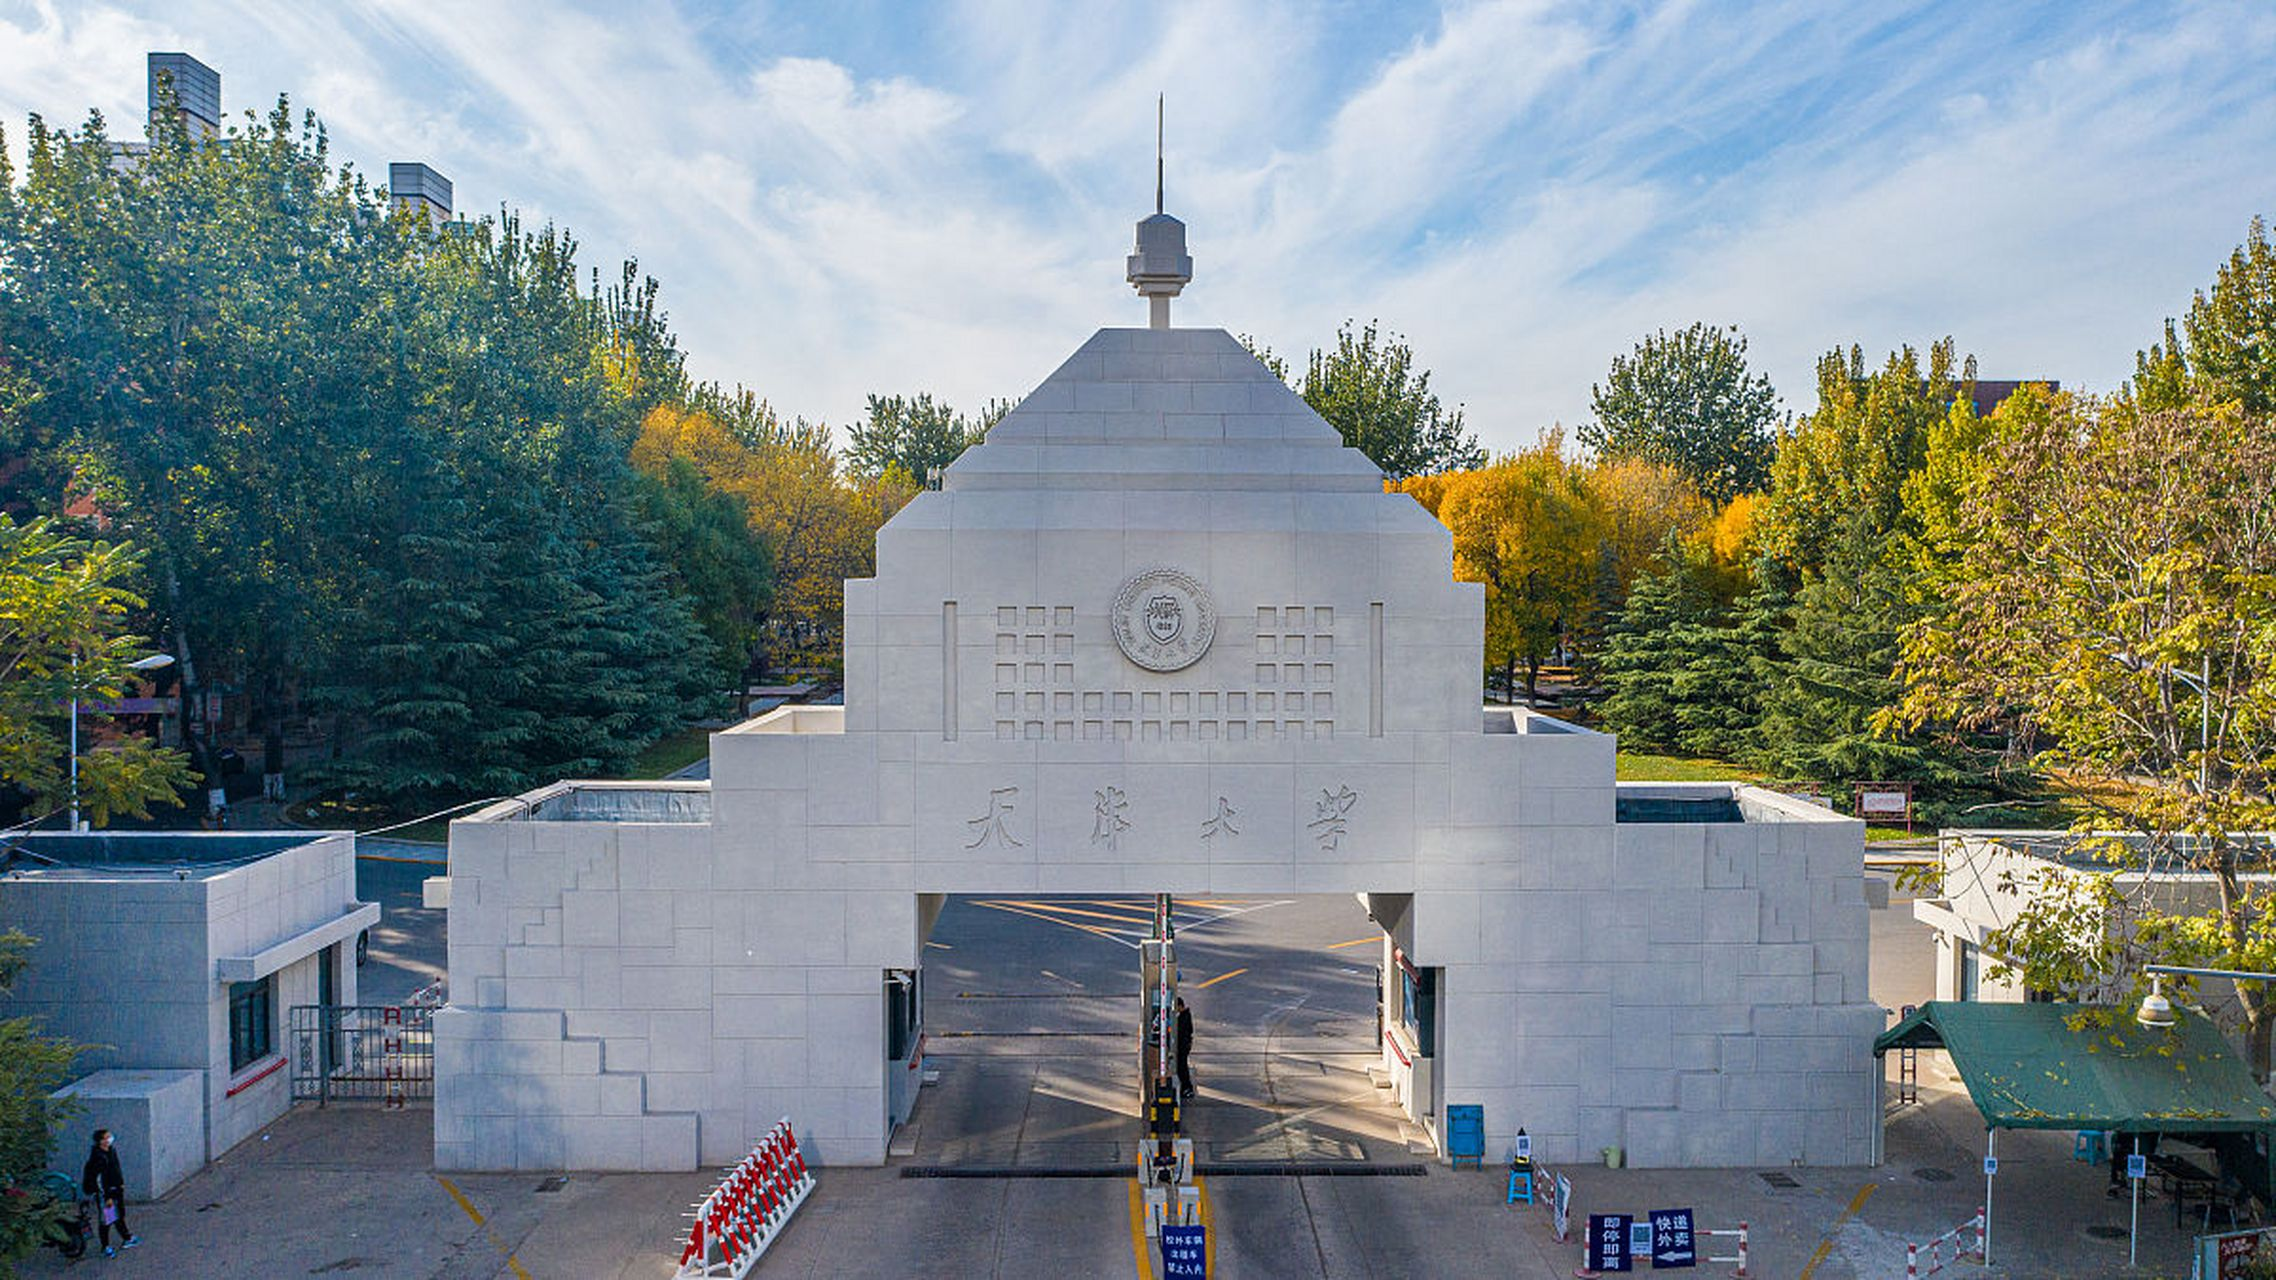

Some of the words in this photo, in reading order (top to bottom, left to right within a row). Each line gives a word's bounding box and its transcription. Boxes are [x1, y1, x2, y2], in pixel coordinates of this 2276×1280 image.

[966, 784, 1357, 851] 天津大学
[1656, 1214, 1689, 1231] 快递
[1657, 1232, 1689, 1247] 外卖
